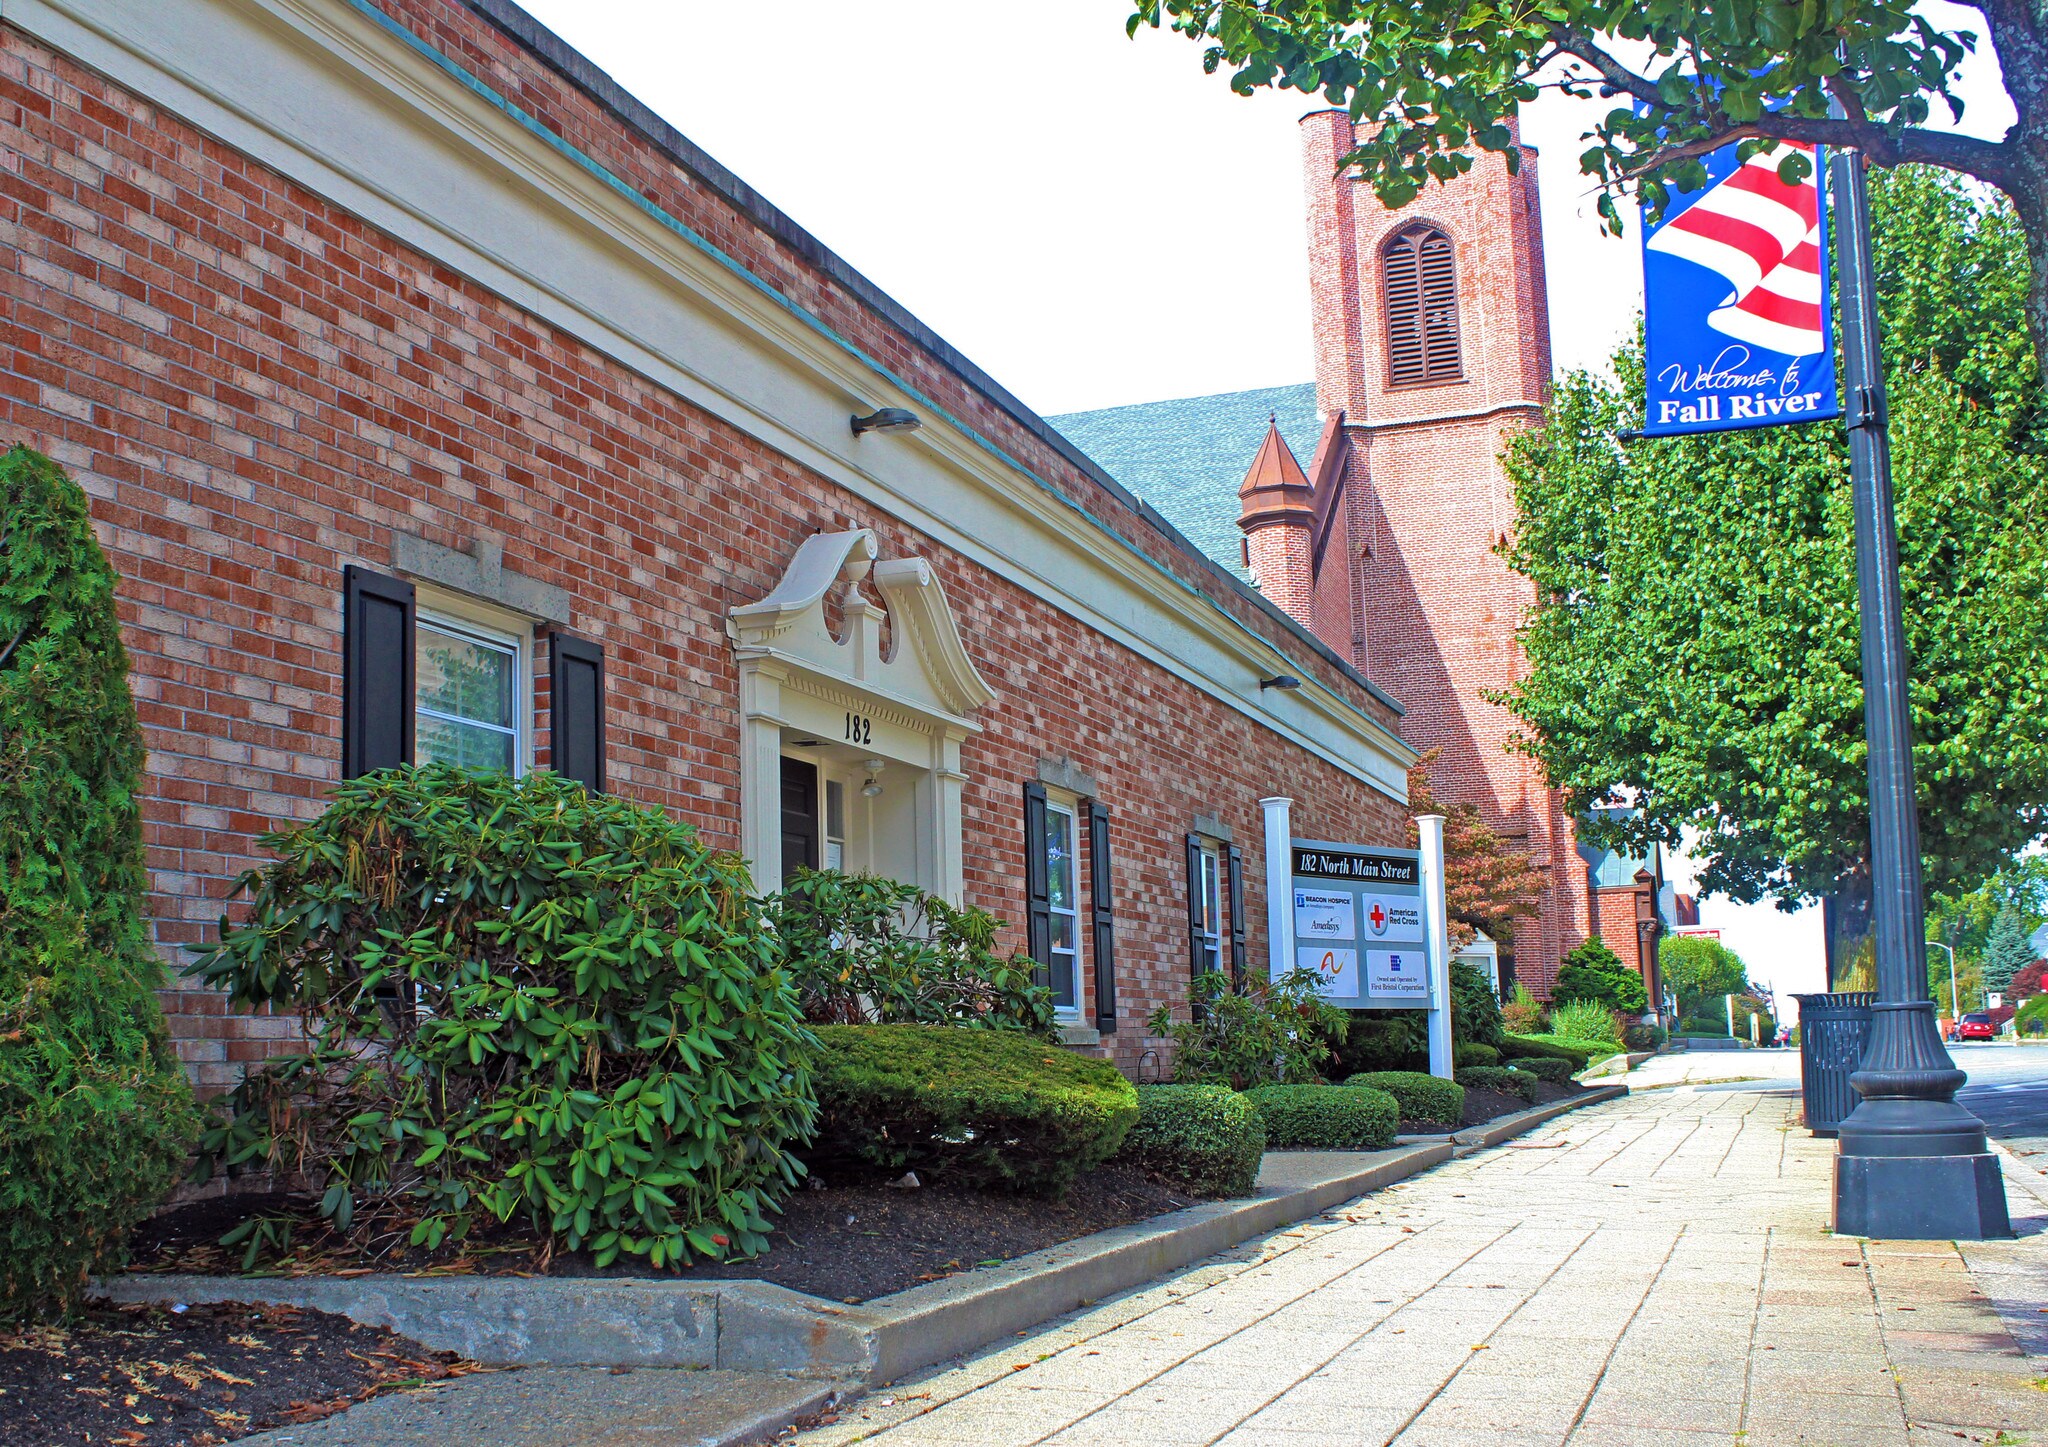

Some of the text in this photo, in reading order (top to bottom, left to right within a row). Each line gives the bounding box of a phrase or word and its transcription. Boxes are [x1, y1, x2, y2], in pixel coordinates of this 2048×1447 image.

[1657, 344, 1801, 397] Welcome to
[1657, 391, 1822, 424] Fall River
[845, 712, 871, 745] 182
[1300, 853, 1411, 879] 182 North Main Street
[1306, 895, 1327, 903] BEACON
[1389, 907, 1418, 917] American
[1389, 916, 1419, 925] Red Cross
[1325, 973, 1336, 984] Arc
[1396, 976, 1412, 984] Operated
[1371, 983, 1425, 993] First Bristol Corporation
